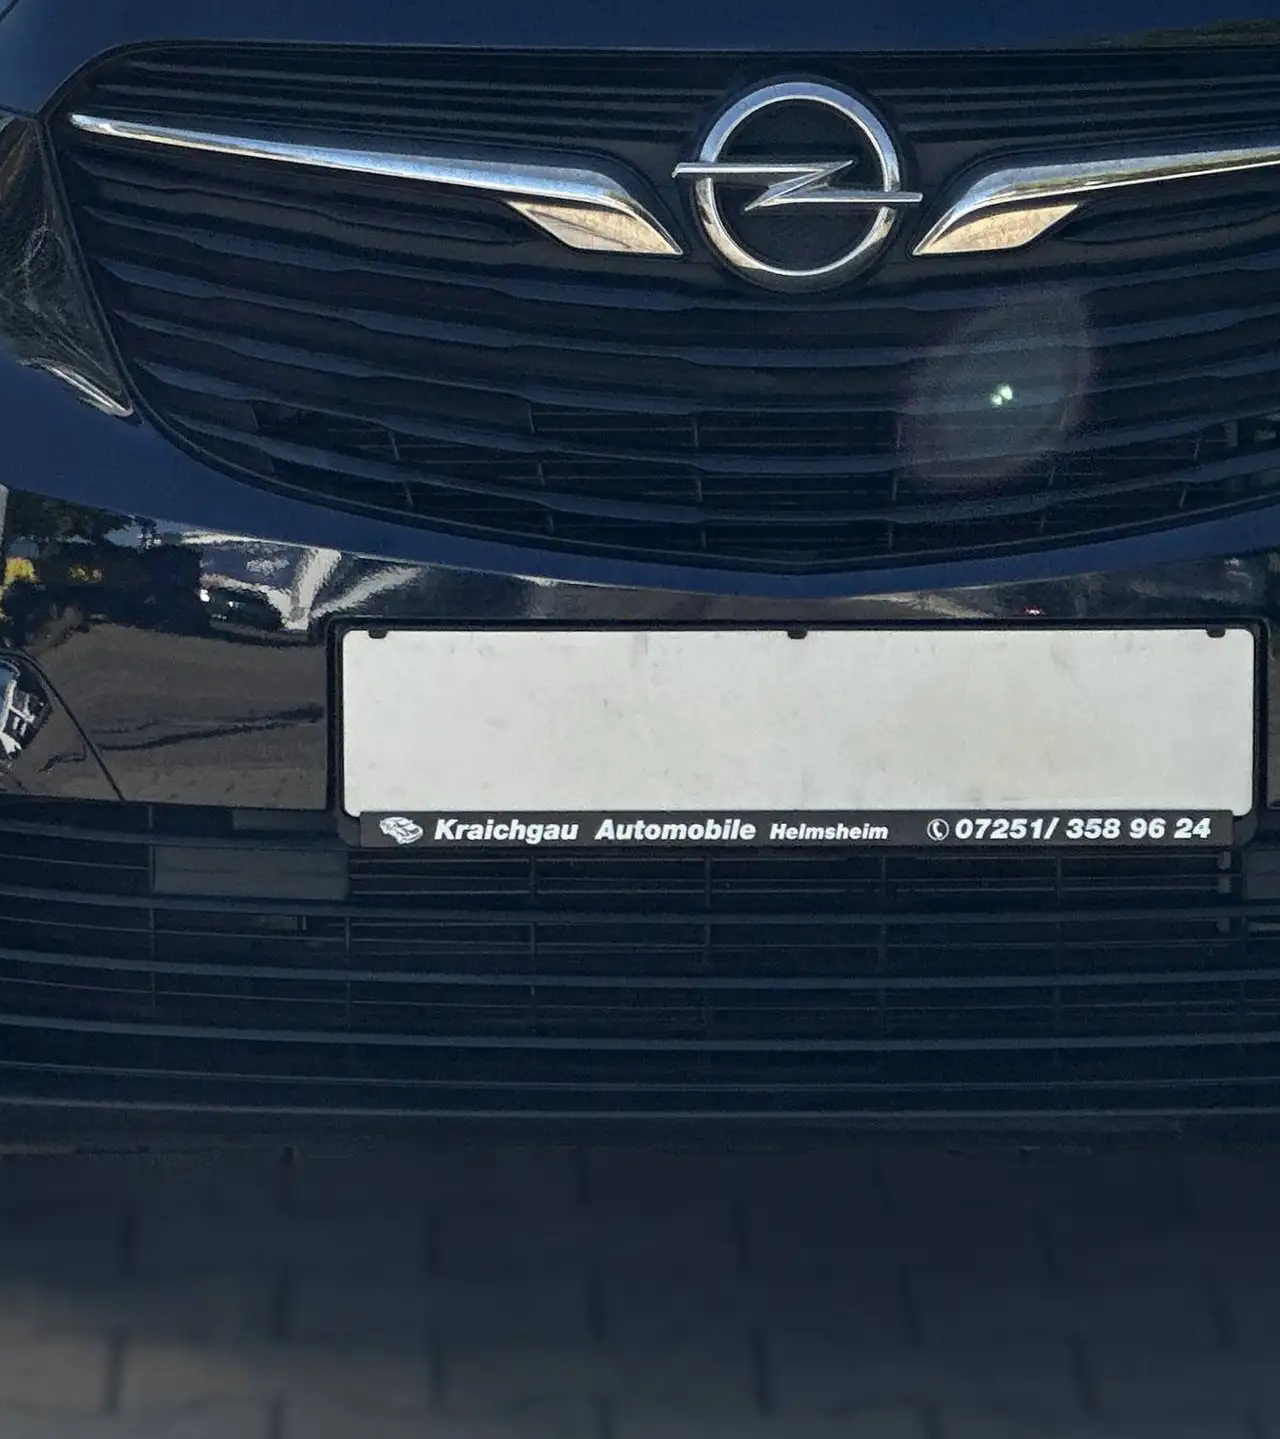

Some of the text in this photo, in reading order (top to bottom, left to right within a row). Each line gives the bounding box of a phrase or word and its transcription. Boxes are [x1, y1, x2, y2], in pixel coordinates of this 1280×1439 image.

[433, 817, 1212, 845] Kraichgau Automobile Helmsheim 07251/ 358 96 24
